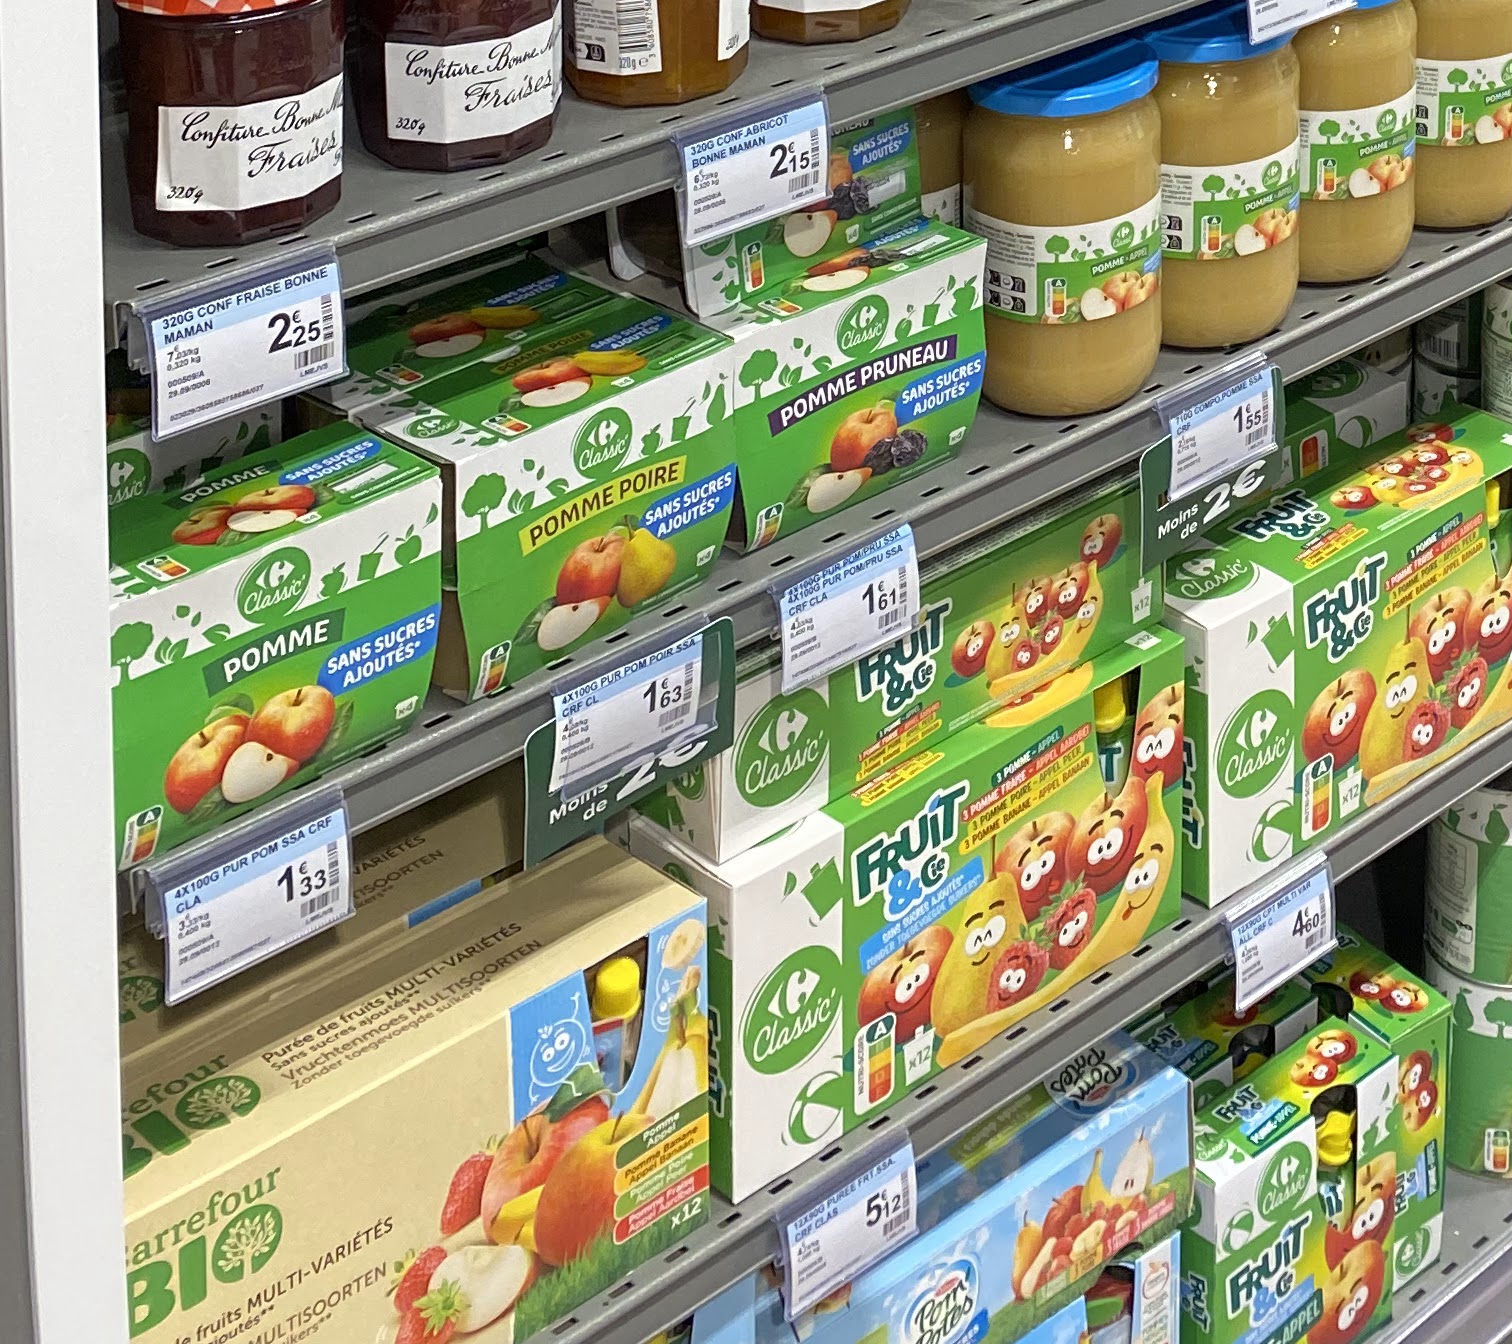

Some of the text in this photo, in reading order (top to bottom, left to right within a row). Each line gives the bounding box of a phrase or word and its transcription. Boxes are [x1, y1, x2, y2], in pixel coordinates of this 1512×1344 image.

[181, 100, 325, 149] Confiture Bonne
[729, 134, 767, 159] MAMAN
[247, 134, 337, 180] Fraises
[1091, 255, 1125, 276] POMME
[162, 266, 329, 331] 320G CONF FRAISE BONNE
[164, 320, 214, 345] MAMAN
[780, 341, 949, 428] POMME PRUNEAU
[529, 462, 681, 547] POMME POIRE
[223, 618, 331, 683] POMME
[327, 613, 436, 675] SANS SUCRES
[308, 816, 333, 840] CRF
[385, 922, 523, 1006] MULTI-VARIÉTÉS
[280, 938, 544, 1080] Vruchtenmoes MULTISOORTEN
[671, 1198, 702, 1230] x12
[246, 1216, 394, 1316] MULTI-VARIÉTÉS
